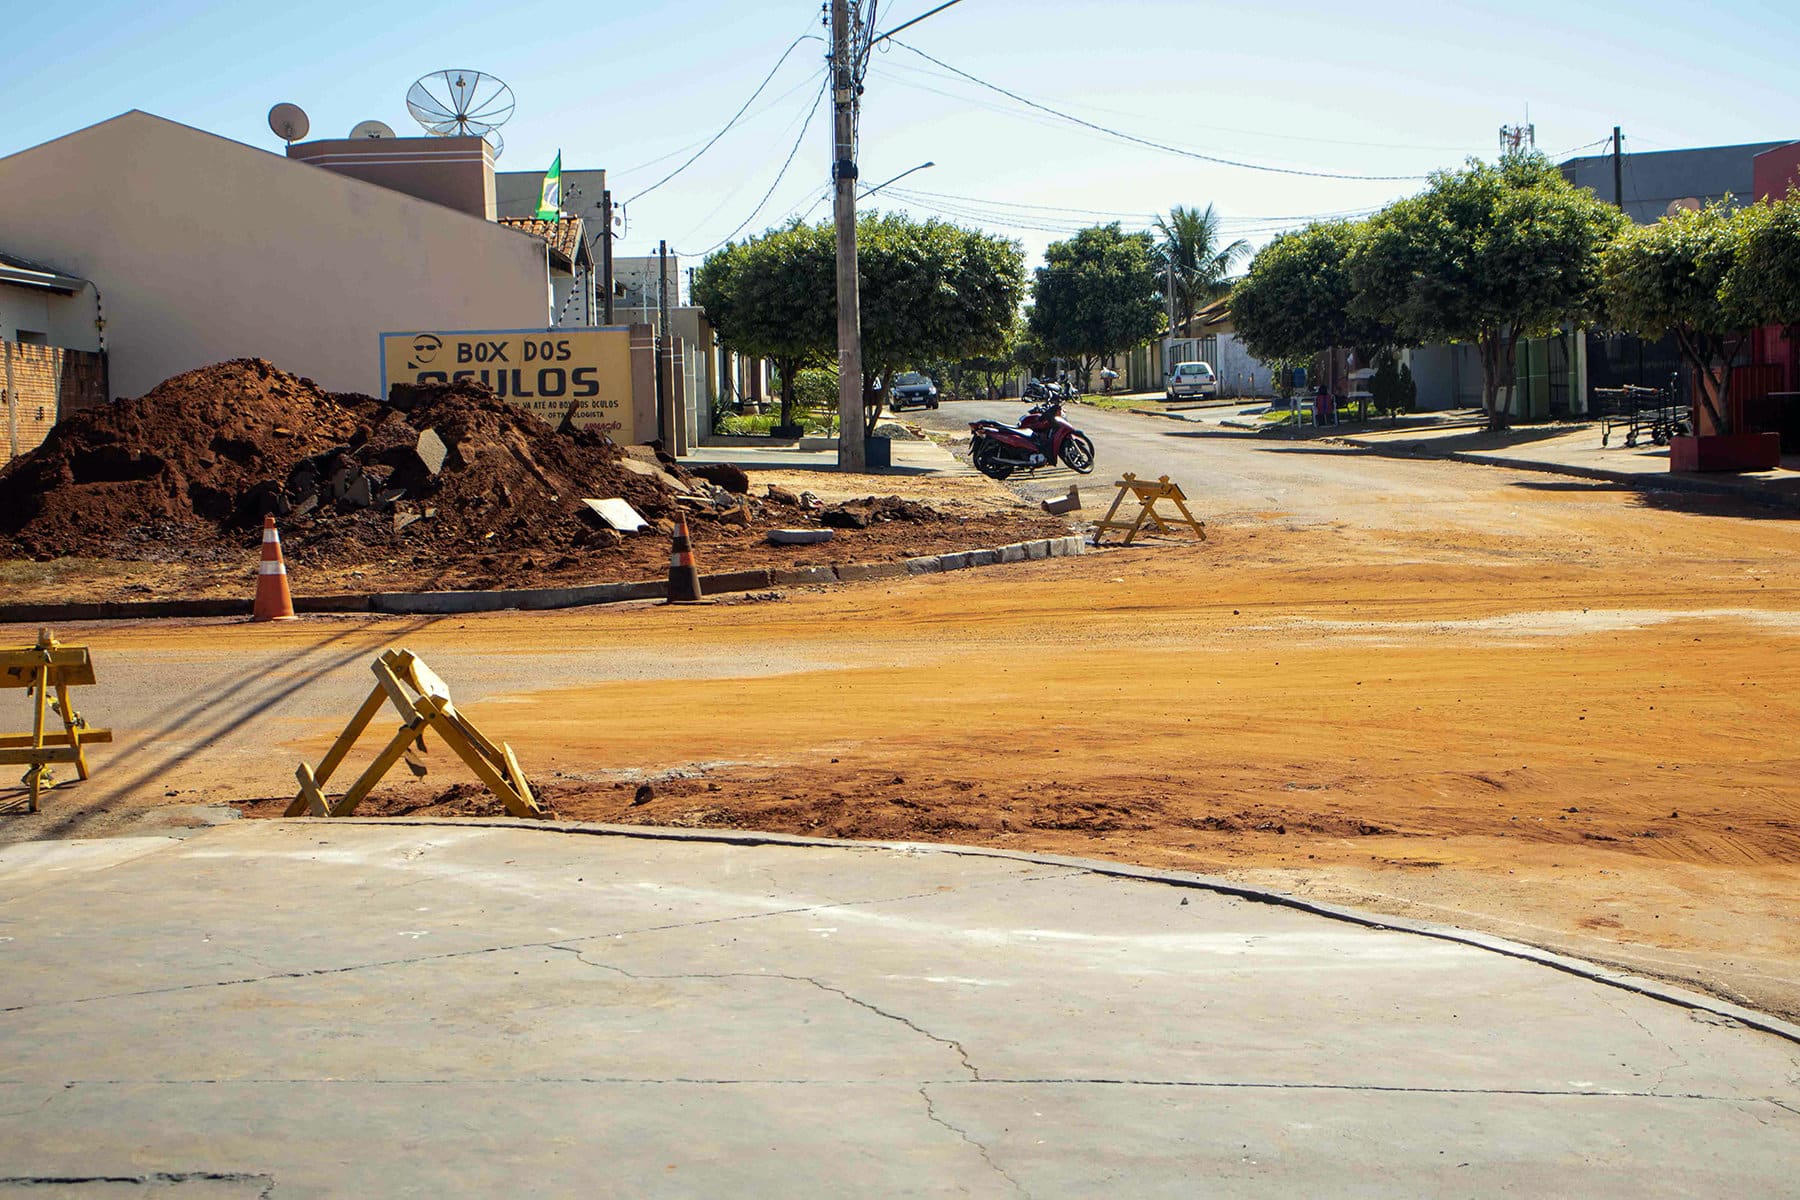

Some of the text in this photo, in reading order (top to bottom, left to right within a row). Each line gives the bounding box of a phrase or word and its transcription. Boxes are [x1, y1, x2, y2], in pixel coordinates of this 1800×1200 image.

[457, 340, 572, 363] BOX DOS
[548, 401, 557, 409] AO
[548, 411, 605, 419] OFTAOLOGISTA
